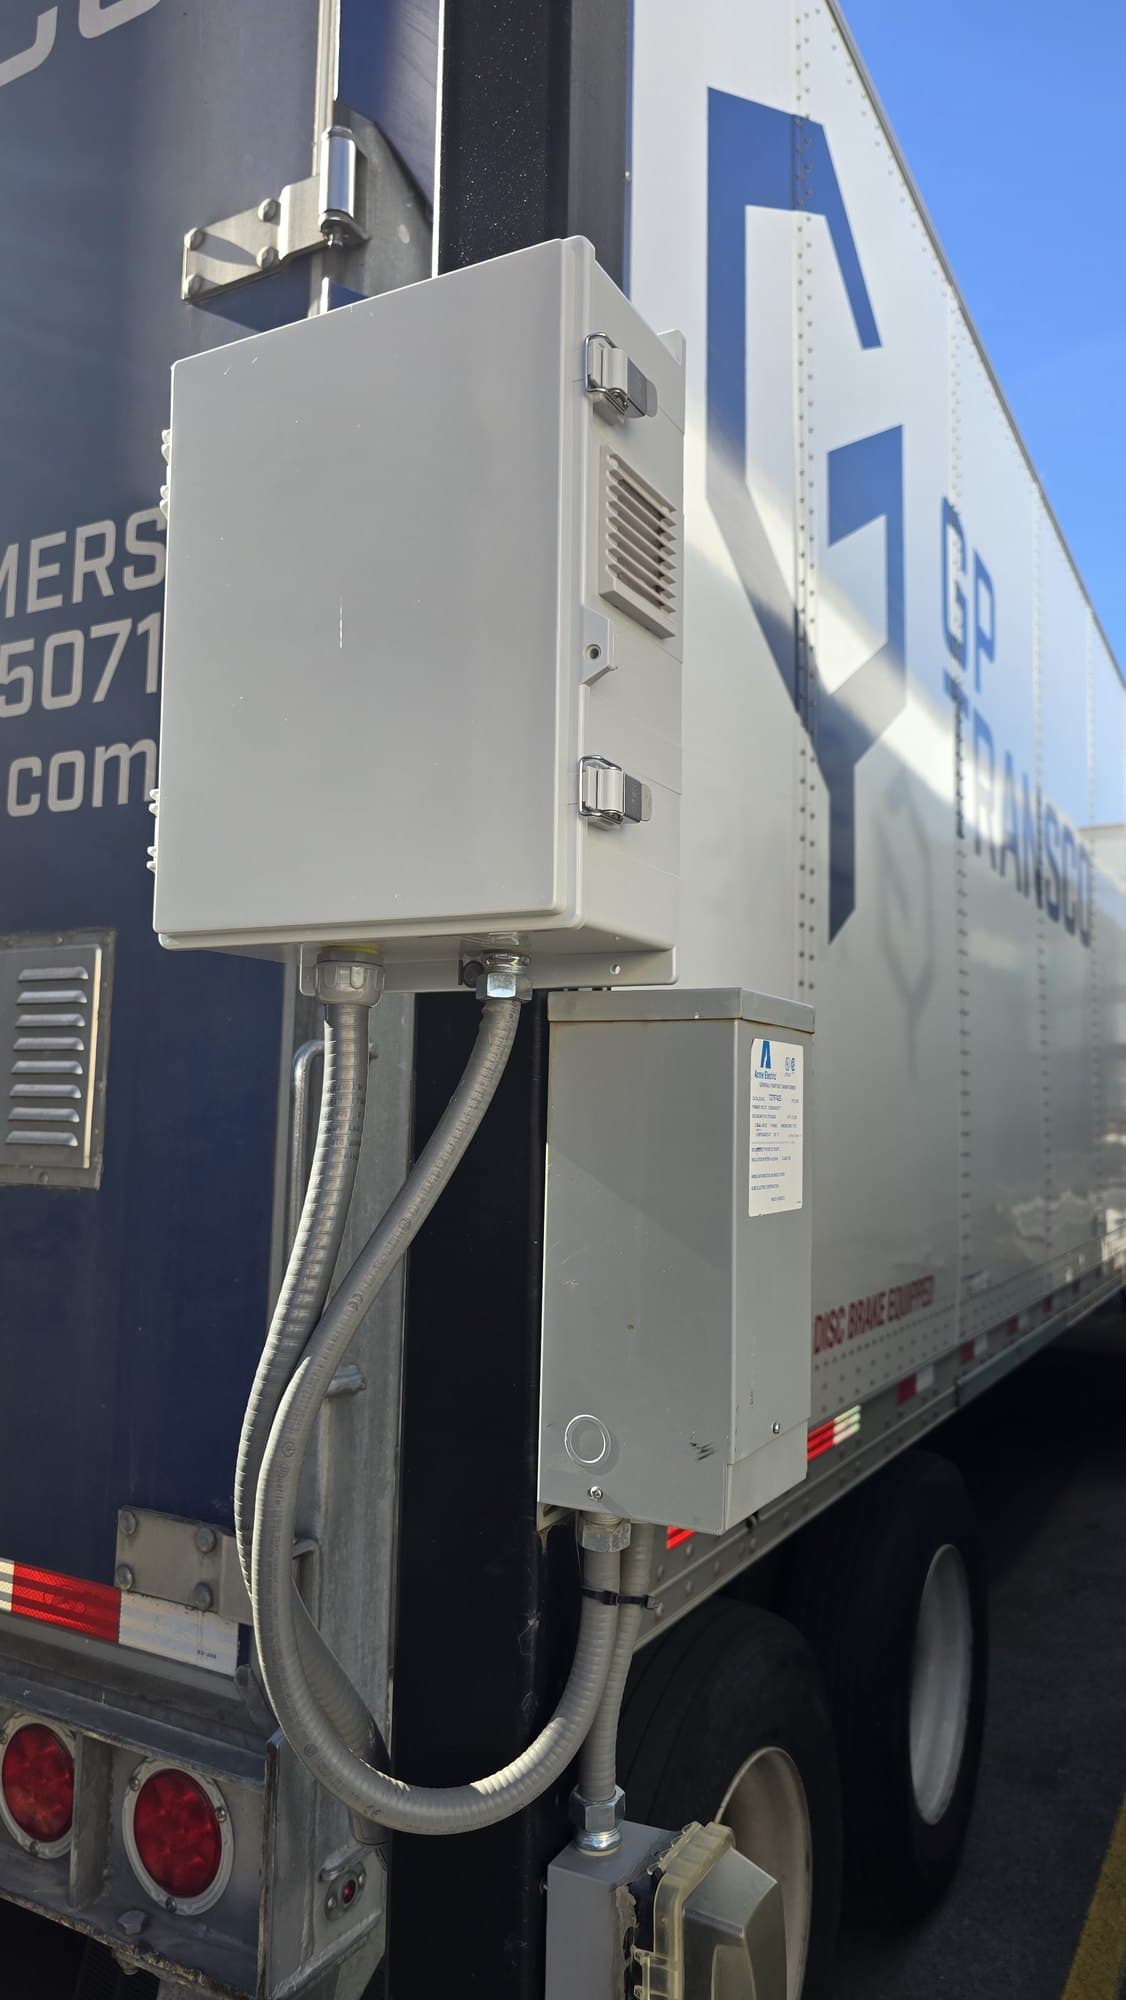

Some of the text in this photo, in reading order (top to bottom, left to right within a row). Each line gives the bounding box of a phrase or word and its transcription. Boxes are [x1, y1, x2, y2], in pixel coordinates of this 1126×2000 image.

[941, 496, 996, 695] GP
[0, 611, 161, 718] 5071
[7, 739, 157, 817] com
[943, 668, 1093, 949] TRANSCO
[813, 1274, 934, 1355] DISC BRAKE EQUIPPED
